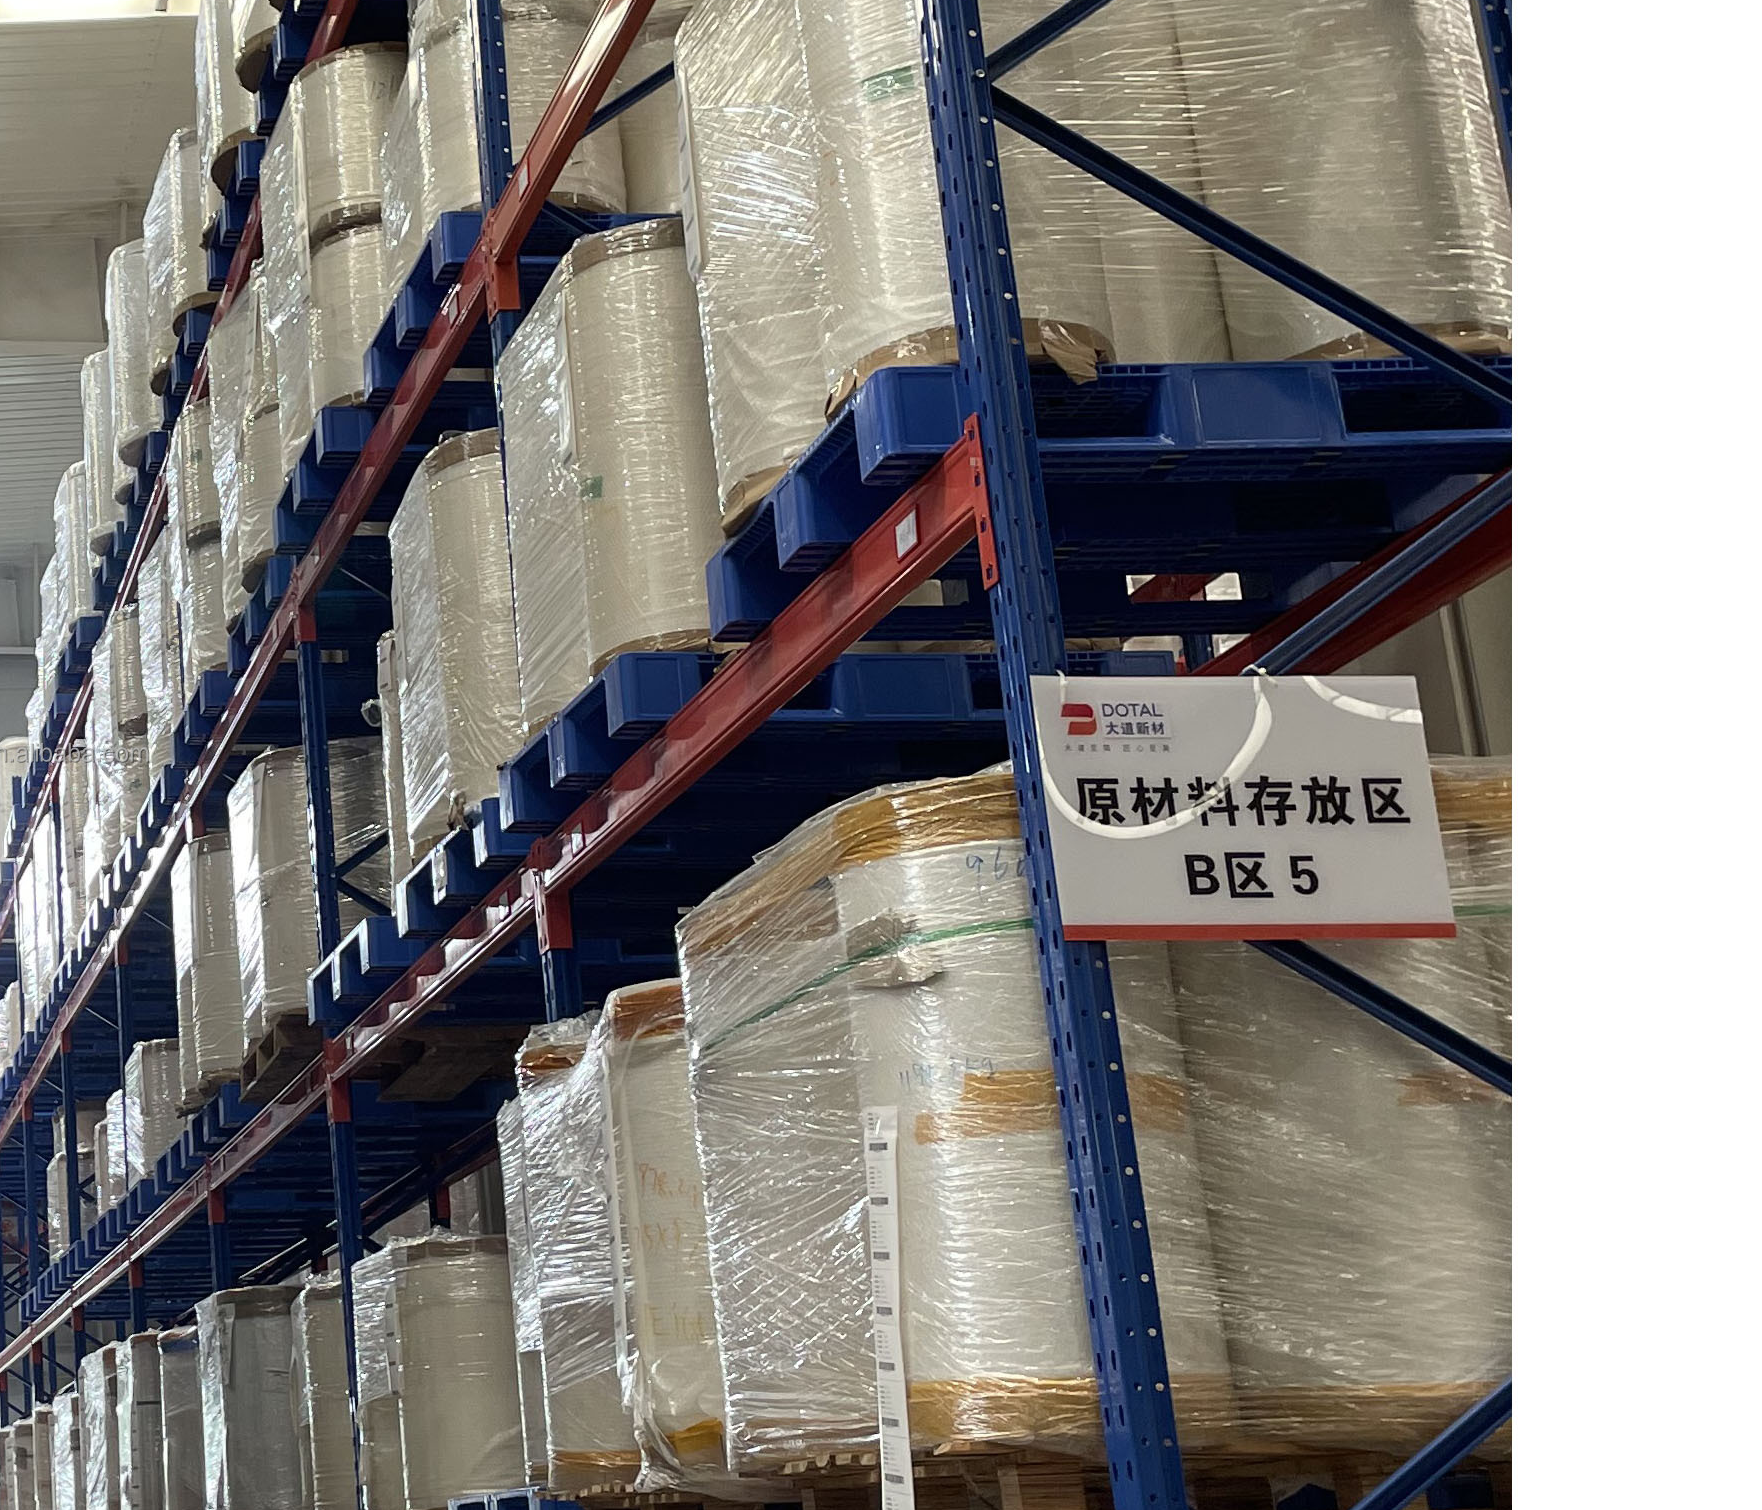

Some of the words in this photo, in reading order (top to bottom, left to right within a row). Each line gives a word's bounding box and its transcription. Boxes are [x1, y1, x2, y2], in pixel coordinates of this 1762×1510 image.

[1101, 702, 1164, 717] DOTAL
[1105, 721, 1165, 735] 大道新材
[1076, 775, 1411, 827] 原材料存放区
[1184, 852, 1275, 899] B区
[1289, 855, 1319, 895] 5
